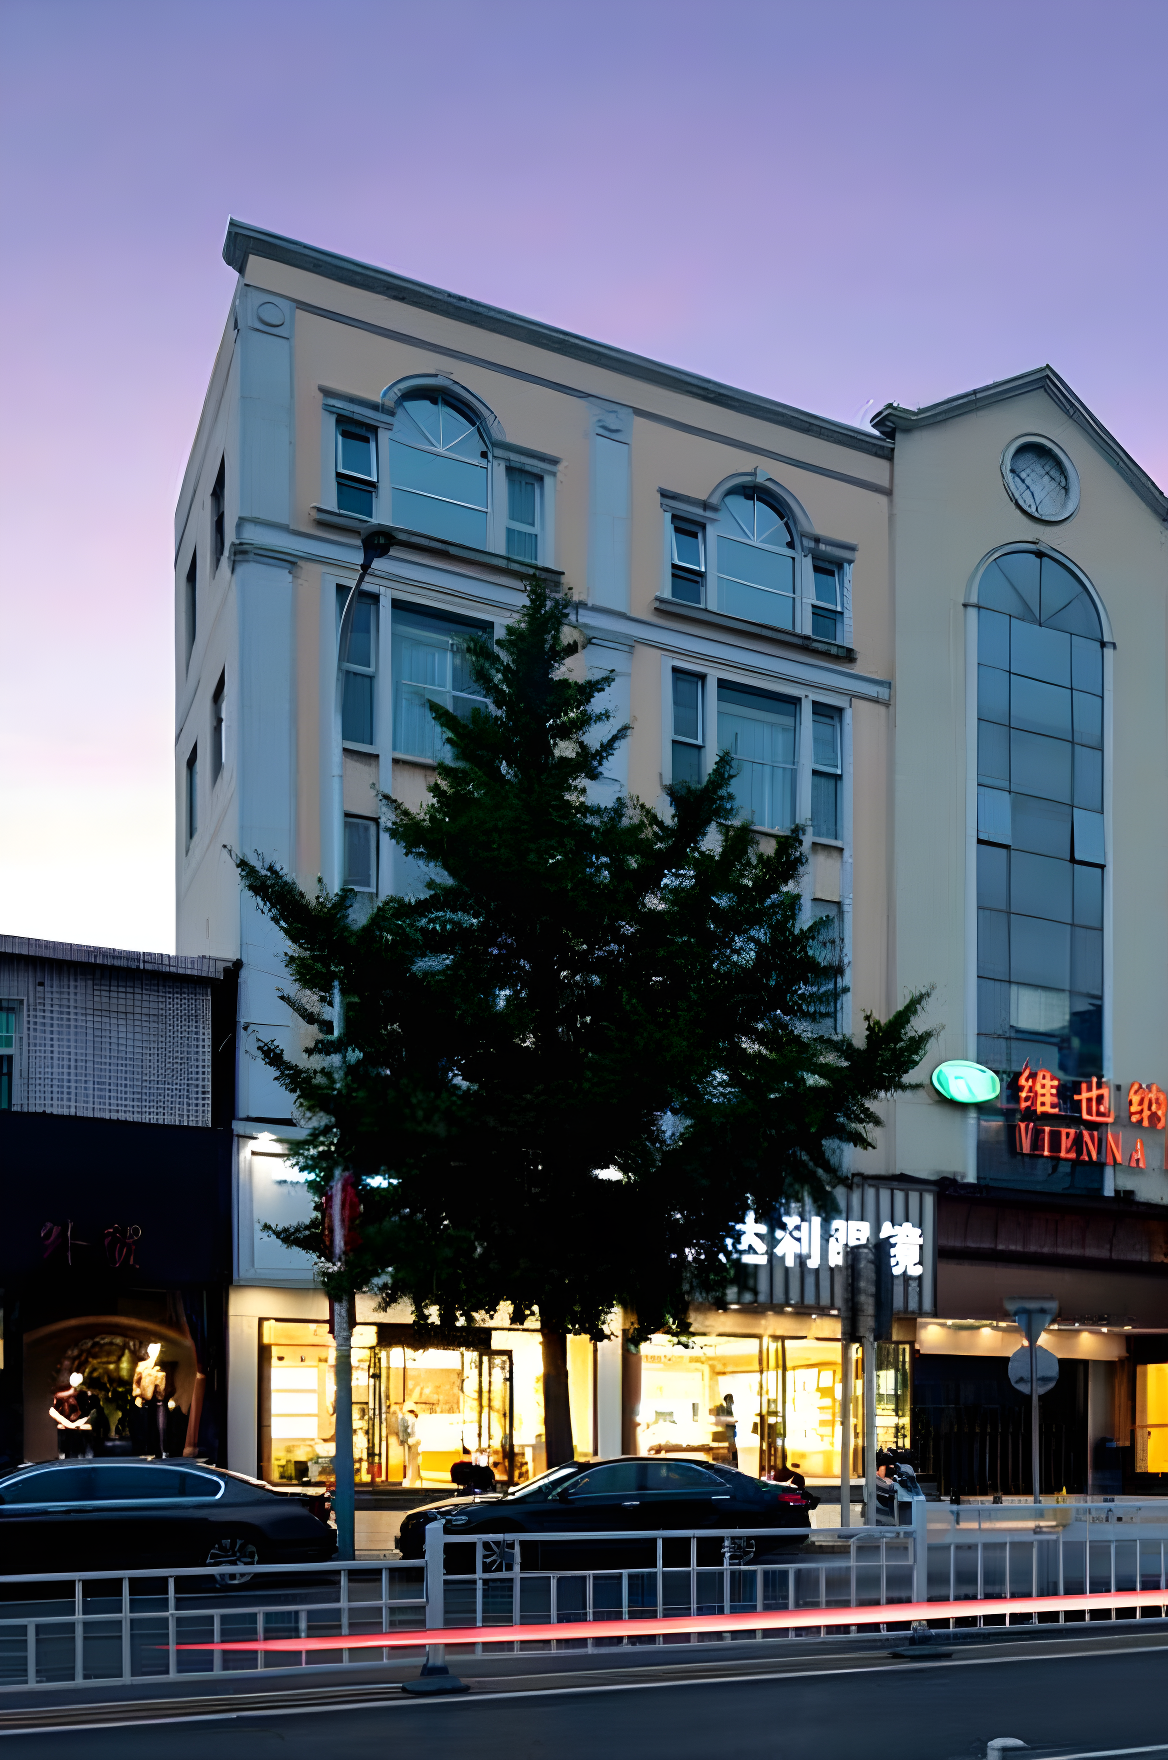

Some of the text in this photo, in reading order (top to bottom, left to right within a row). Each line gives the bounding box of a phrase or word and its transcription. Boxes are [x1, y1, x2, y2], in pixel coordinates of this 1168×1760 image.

[1016, 1121, 1146, 1169] VIENNA
[684, 1210, 924, 1276] 达利眼镜
